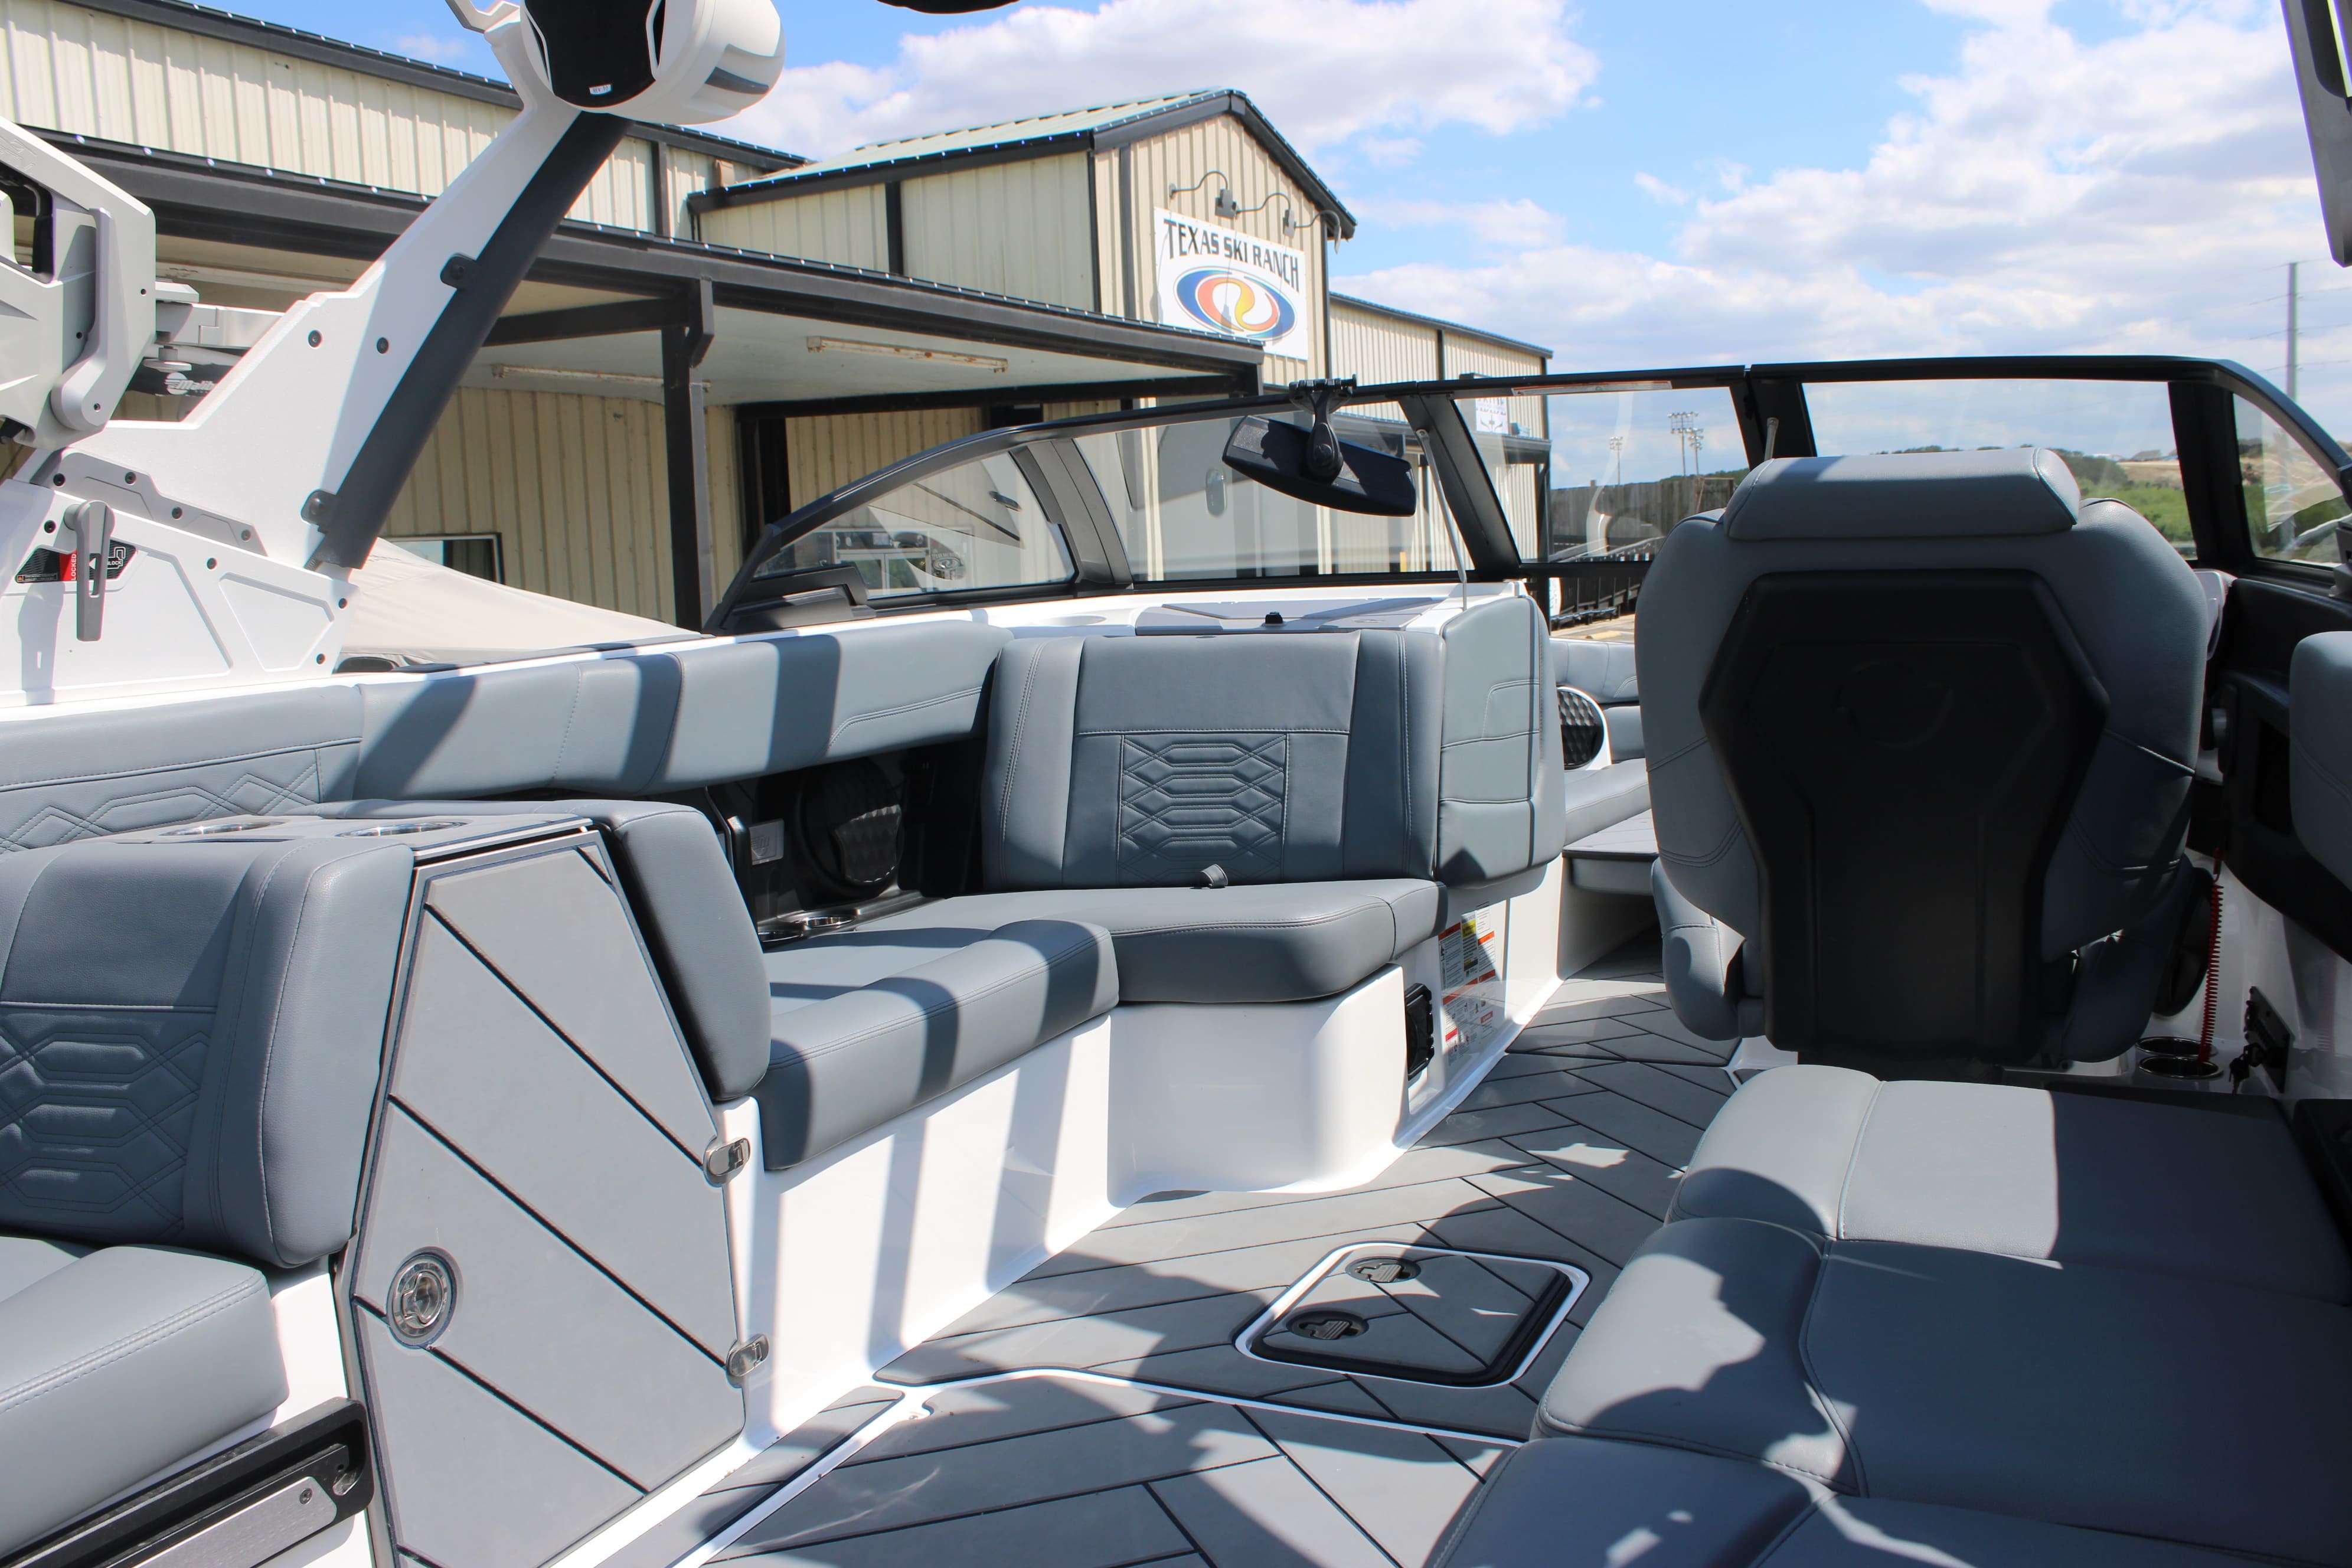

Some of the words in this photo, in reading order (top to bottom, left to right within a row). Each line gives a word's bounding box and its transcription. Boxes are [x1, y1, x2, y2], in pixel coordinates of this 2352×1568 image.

[1164, 217, 1220, 260] TEXAS
[1223, 236, 1248, 263] SKI
[1252, 244, 1300, 293] RANCH
[178, 380, 216, 390] Malib
